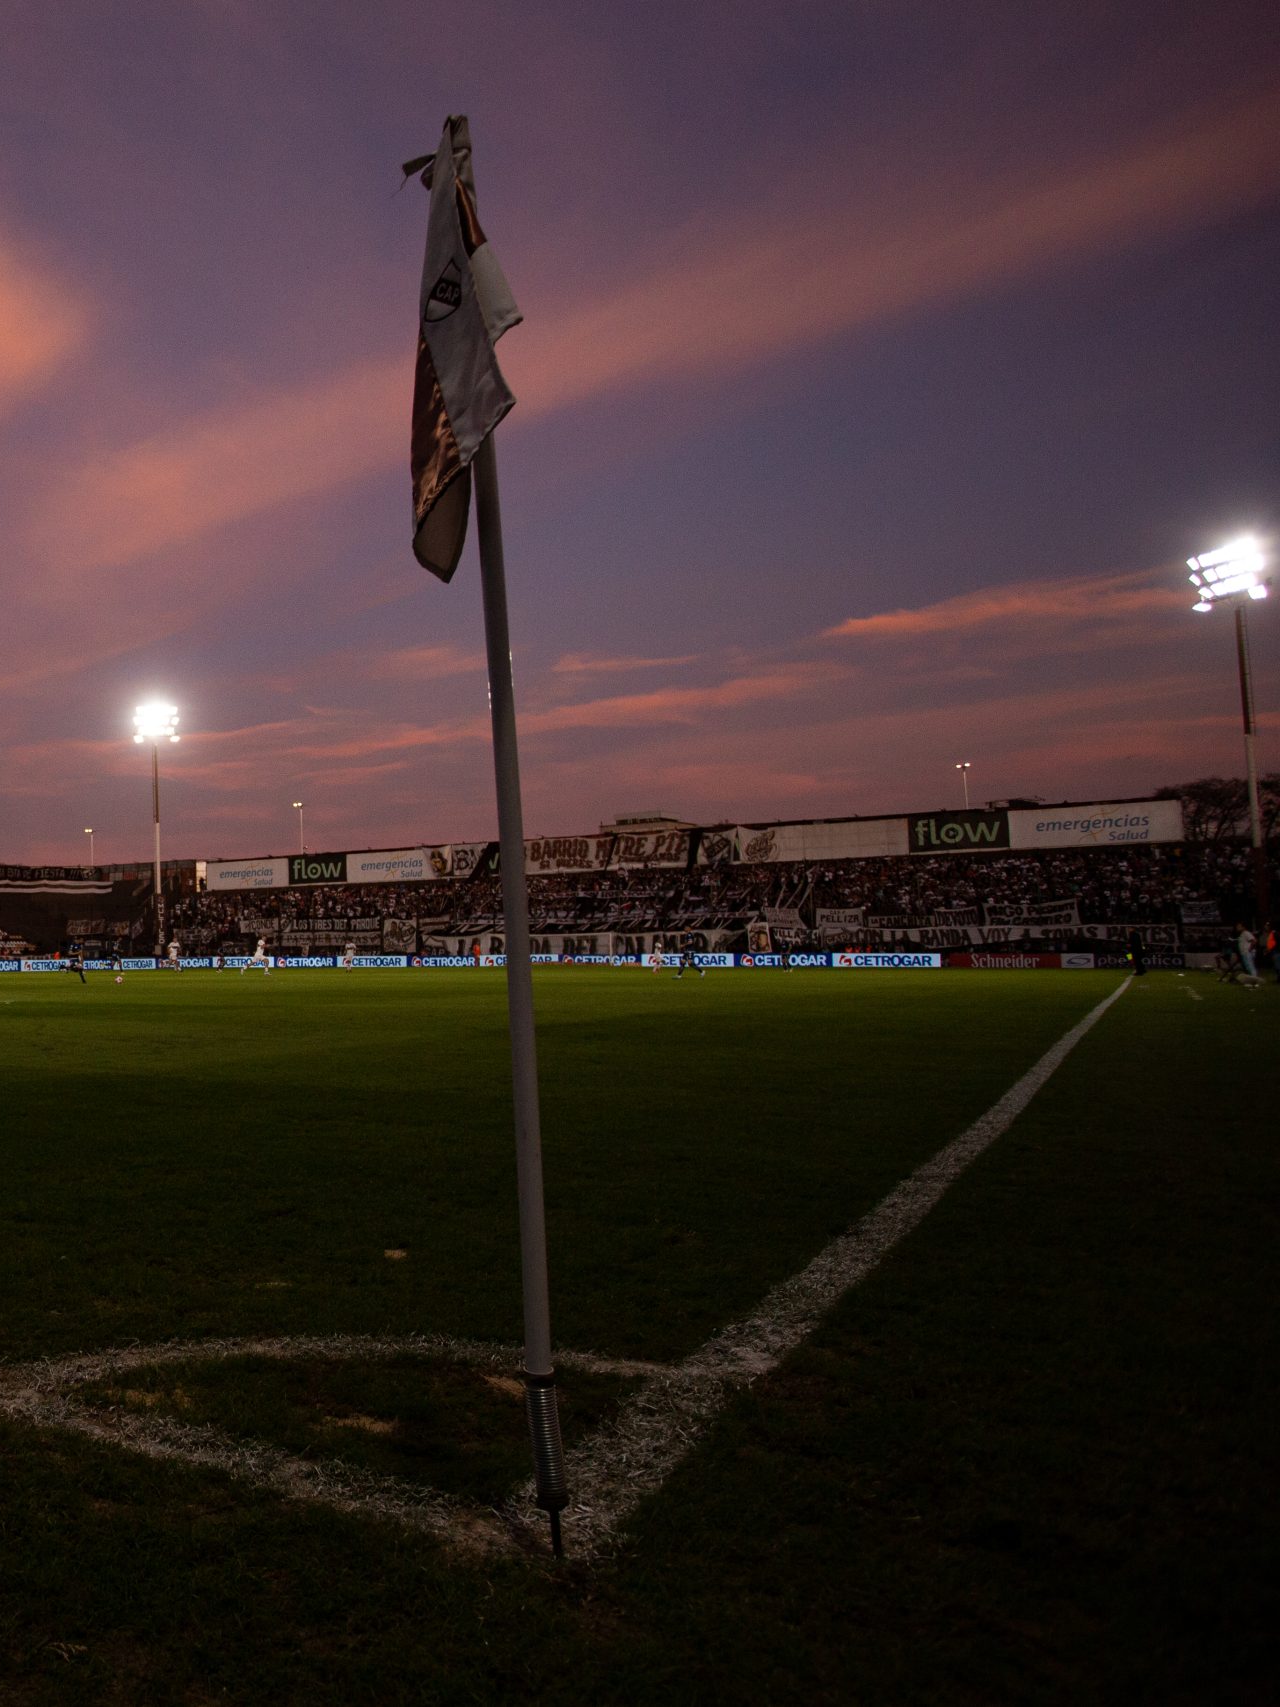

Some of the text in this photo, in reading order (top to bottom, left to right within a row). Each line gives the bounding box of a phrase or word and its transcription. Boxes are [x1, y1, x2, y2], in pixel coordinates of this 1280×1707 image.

[436, 282, 460, 303] CAP
[1036, 814, 1149, 833] emergencias
[914, 818, 1001, 846] flow
[1109, 829, 1148, 842] Salud
[531, 839, 589, 861] BARRIO
[293, 858, 342, 881] flow
[361, 859, 423, 872] emergencias
[220, 867, 273, 881] emergencias
[400, 870, 423, 879] Salud
[254, 878, 273, 886] Salud
[293, 919, 308, 930] LOS
[350, 918, 380, 929] PARQUE
[922, 930, 969, 948] BANDA
[978, 927, 1012, 944] VOY
[1106, 926, 1175, 945] PATES
[123, 959, 153, 969] CETROGAR
[287, 957, 333, 968] CETROGAR
[352, 957, 401, 968] CETROGAR
[423, 956, 475, 967] CETROGAR
[662, 955, 727, 966] CETOGAR
[855, 955, 932, 967] CETROGAR
[970, 953, 1041, 968] Schneider
